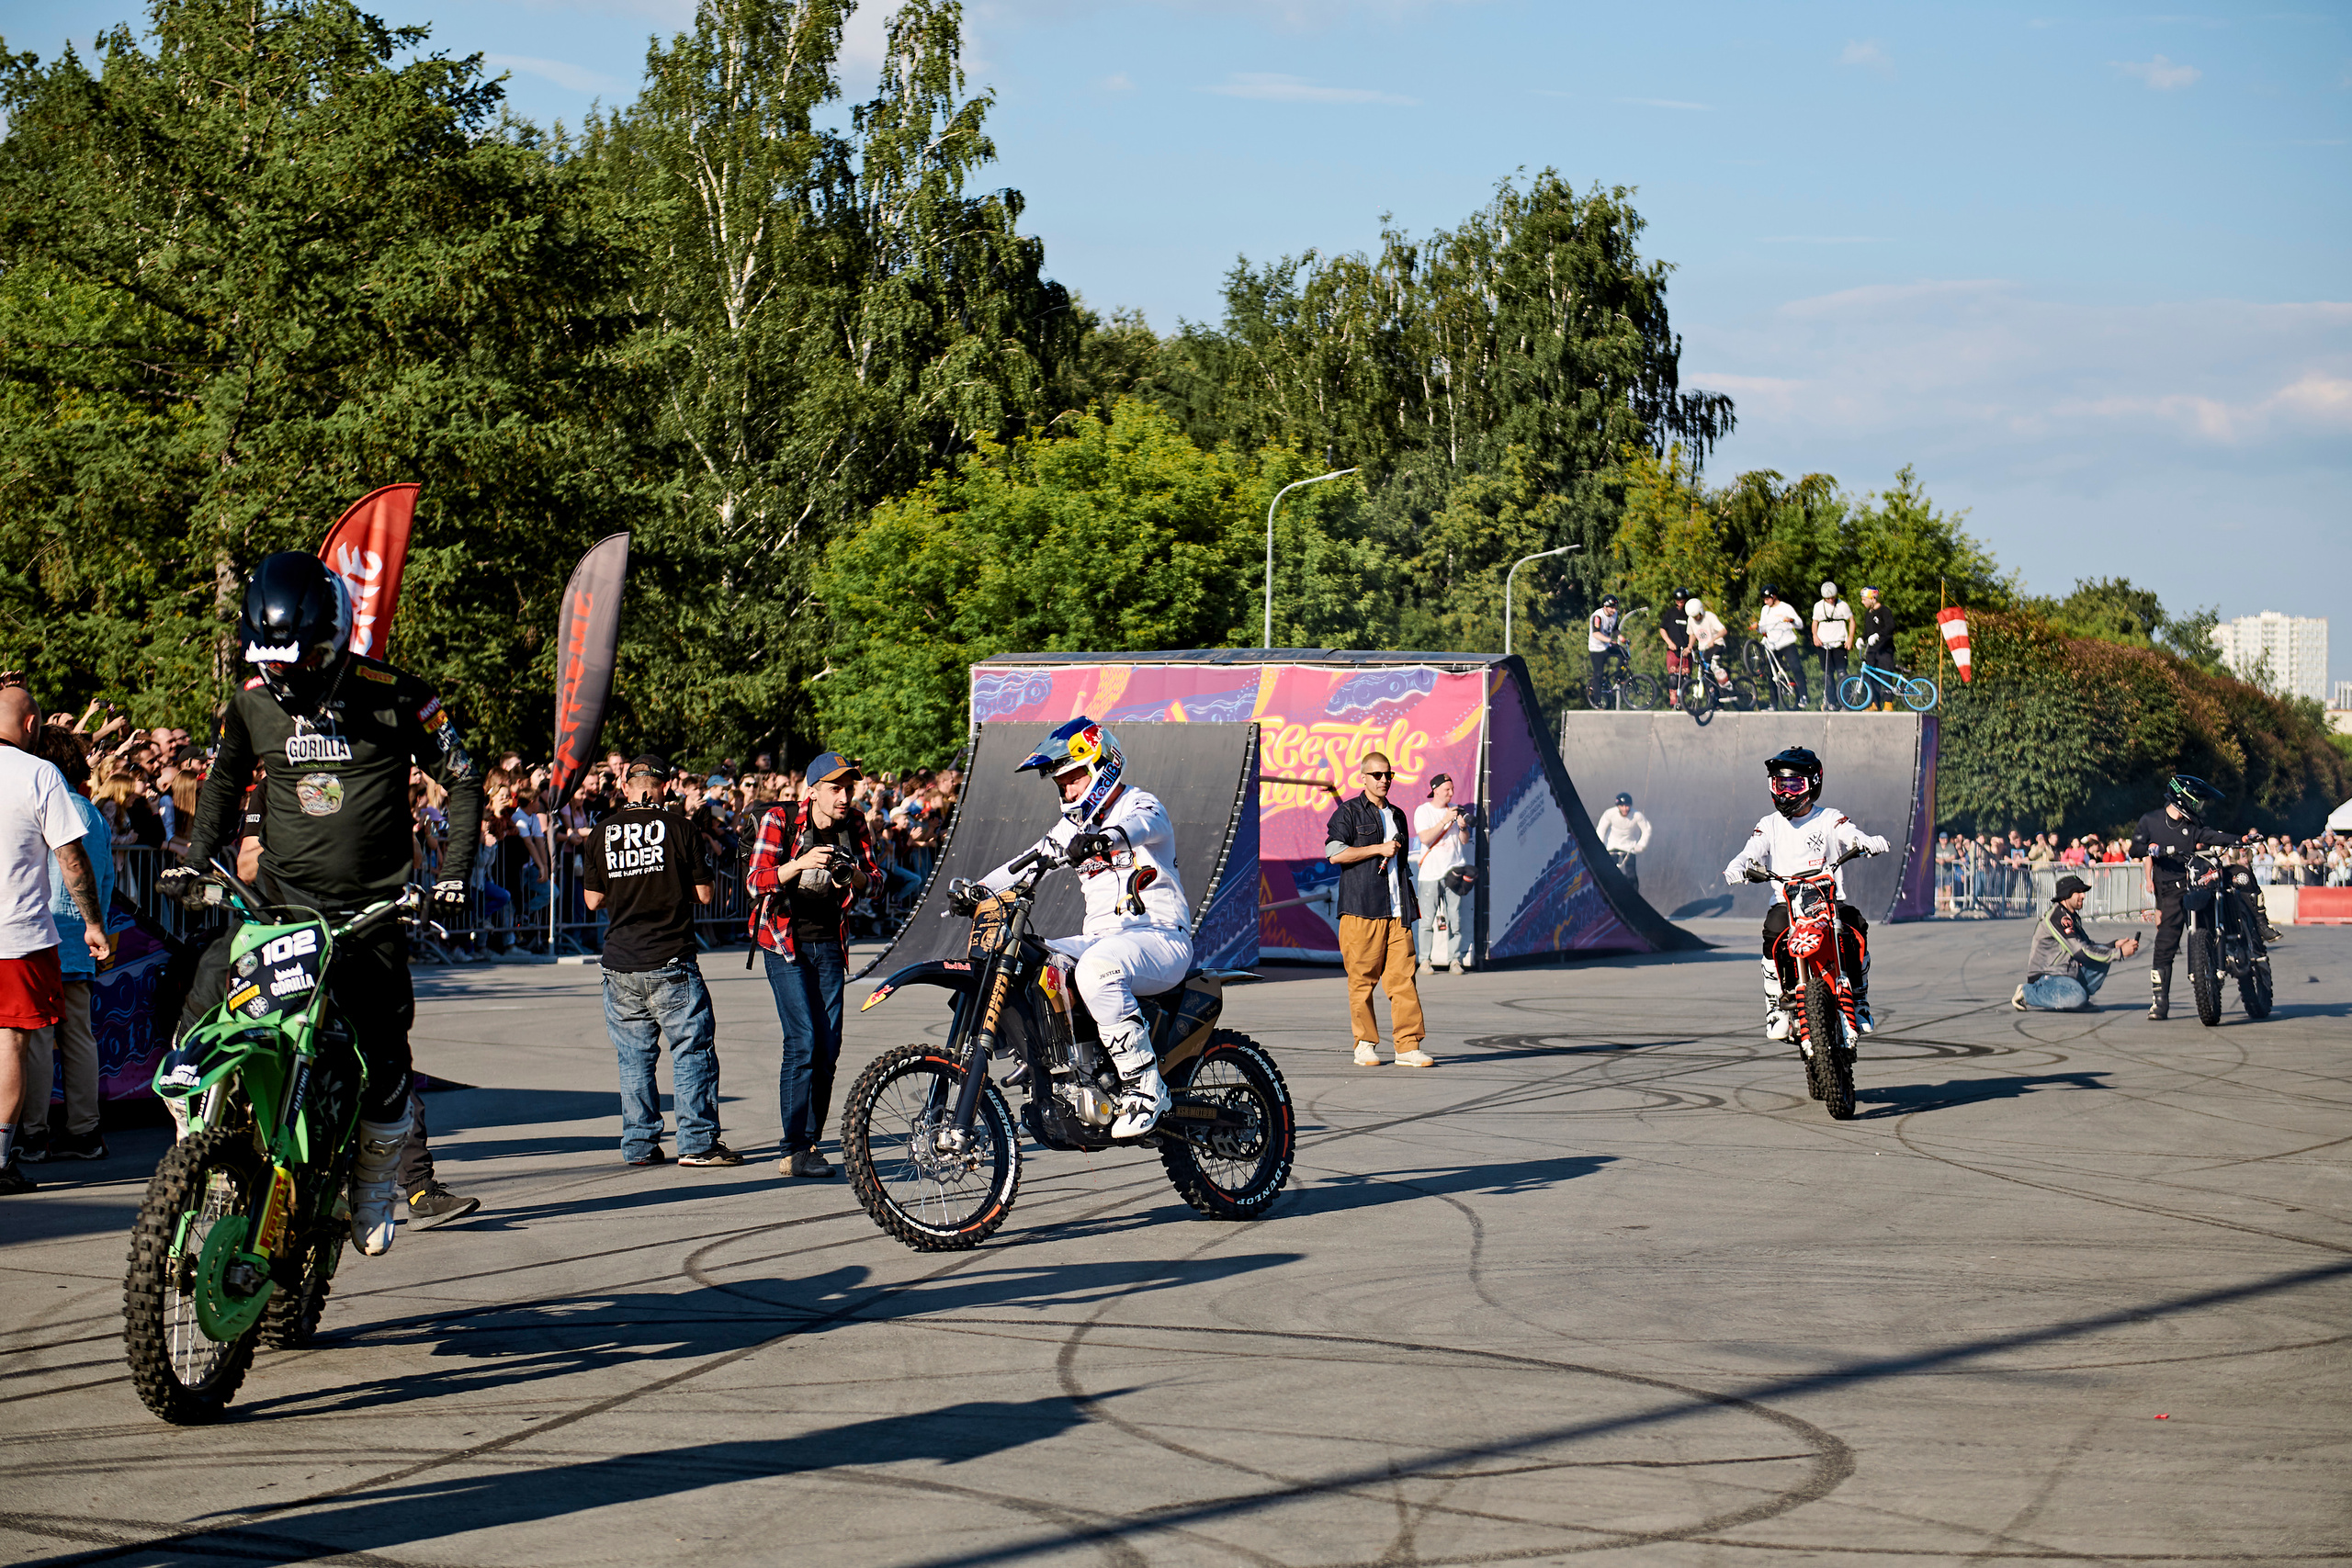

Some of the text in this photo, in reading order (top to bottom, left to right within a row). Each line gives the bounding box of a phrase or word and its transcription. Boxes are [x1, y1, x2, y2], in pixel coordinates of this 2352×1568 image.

[289, 739, 348, 759] GORILLA
[1085, 745, 1124, 807] Red Bull
[605, 819, 665, 852] PRO
[605, 845, 664, 871] RIDER
[434, 891, 466, 903] FOX
[262, 929, 317, 966] 102
[270, 974, 315, 997] GORILLA
[989, 973, 1004, 1009] RACING
[1236, 1168, 1283, 1206] DUNLOP
